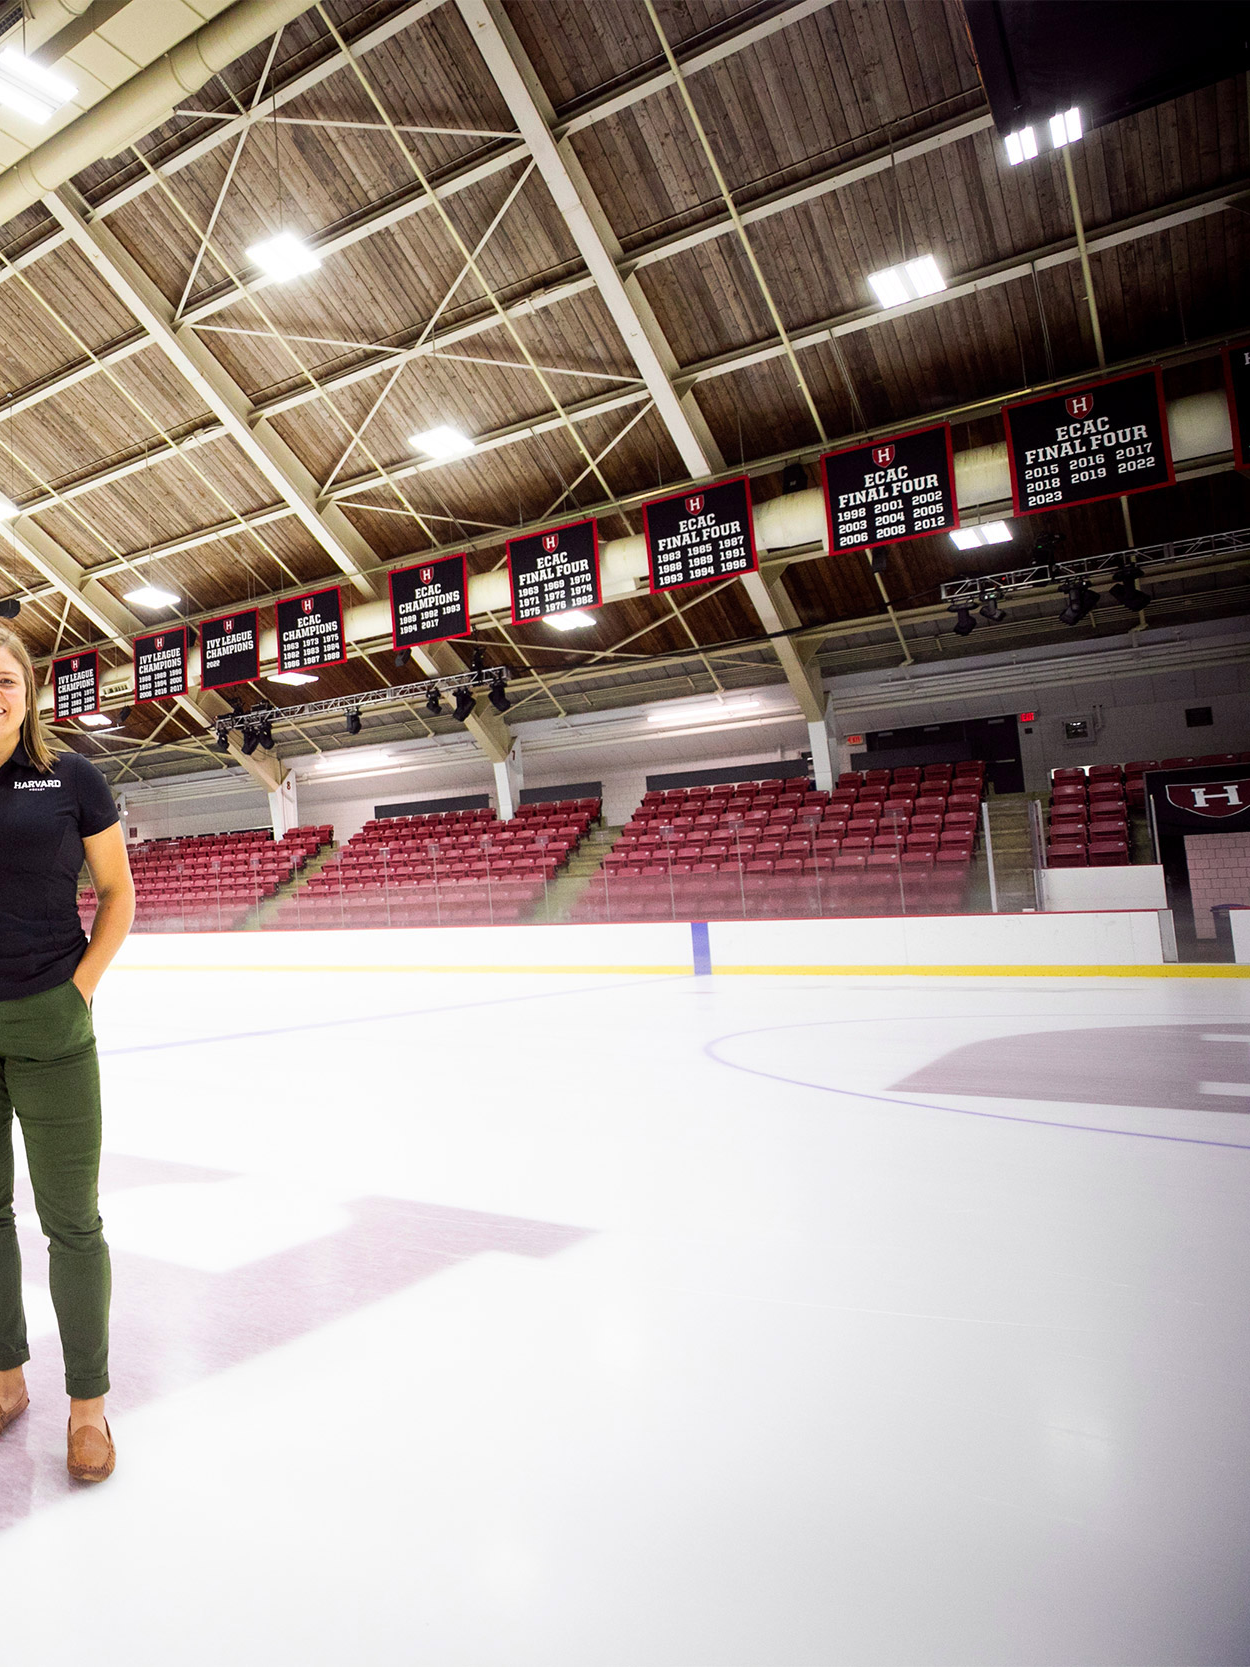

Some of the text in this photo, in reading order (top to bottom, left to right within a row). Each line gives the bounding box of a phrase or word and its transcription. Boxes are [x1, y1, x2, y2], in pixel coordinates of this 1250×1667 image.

[1072, 397, 1088, 414] H
[1055, 416, 1110, 442] ECAC
[1025, 424, 1148, 465] FINAL FOUR
[877, 448, 890, 463] H
[1025, 442, 1153, 480] 2015 2016 2017
[864, 465, 908, 488] ECAC
[1026, 456, 1156, 493] 2018 2019 2022
[838, 474, 939, 509] FINAL FOUR
[1028, 491, 1062, 507] 2023
[689, 498, 701, 511] H
[838, 490, 942, 523] 1998 2001 2002
[679, 513, 716, 533] ECAC
[839, 503, 944, 535] 2003 2004 2005
[658, 520, 741, 552] FINAL FOUR
[840, 516, 945, 547] 2006 2008 2012
[546, 536, 555, 549] H
[657, 535, 744, 563] 1983 1985 1987
[536, 551, 568, 570] ECAC
[658, 547, 745, 575] 1988 1989 1991
[423, 569, 430, 581] H
[518, 559, 589, 586] FINAL FOUR
[659, 559, 747, 586] 1993 1994 1996
[415, 583, 441, 599] ECAC
[544, 579, 565, 592] 1969
[570, 573, 591, 586] 1970
[304, 600, 311, 611] H
[399, 590, 460, 615] CHAMPIONS
[519, 584, 592, 608] 1971 1972 1974
[297, 614, 321, 628] ECAC
[520, 606, 540, 619] 1975
[226, 620, 232, 630] H
[283, 621, 338, 642] CHAMPIONS
[421, 619, 439, 630] 2017
[157, 638, 162, 647] H
[206, 630, 252, 650] IVY LEAGUE
[206, 640, 254, 659] CHAMPIONS
[303, 638, 319, 647] 1973
[323, 633, 339, 643] 1975
[73, 660, 78, 669] H
[139, 657, 181, 674] CHAMPIONS
[140, 647, 181, 665] IVY LEAGUE
[206, 660, 220, 669] 2022
[58, 669, 93, 685] IVY LEAGUE
[58, 678, 94, 694] CHAMPIONS
[14, 780, 61, 789] HARVARD
[1191, 785, 1243, 807] H
